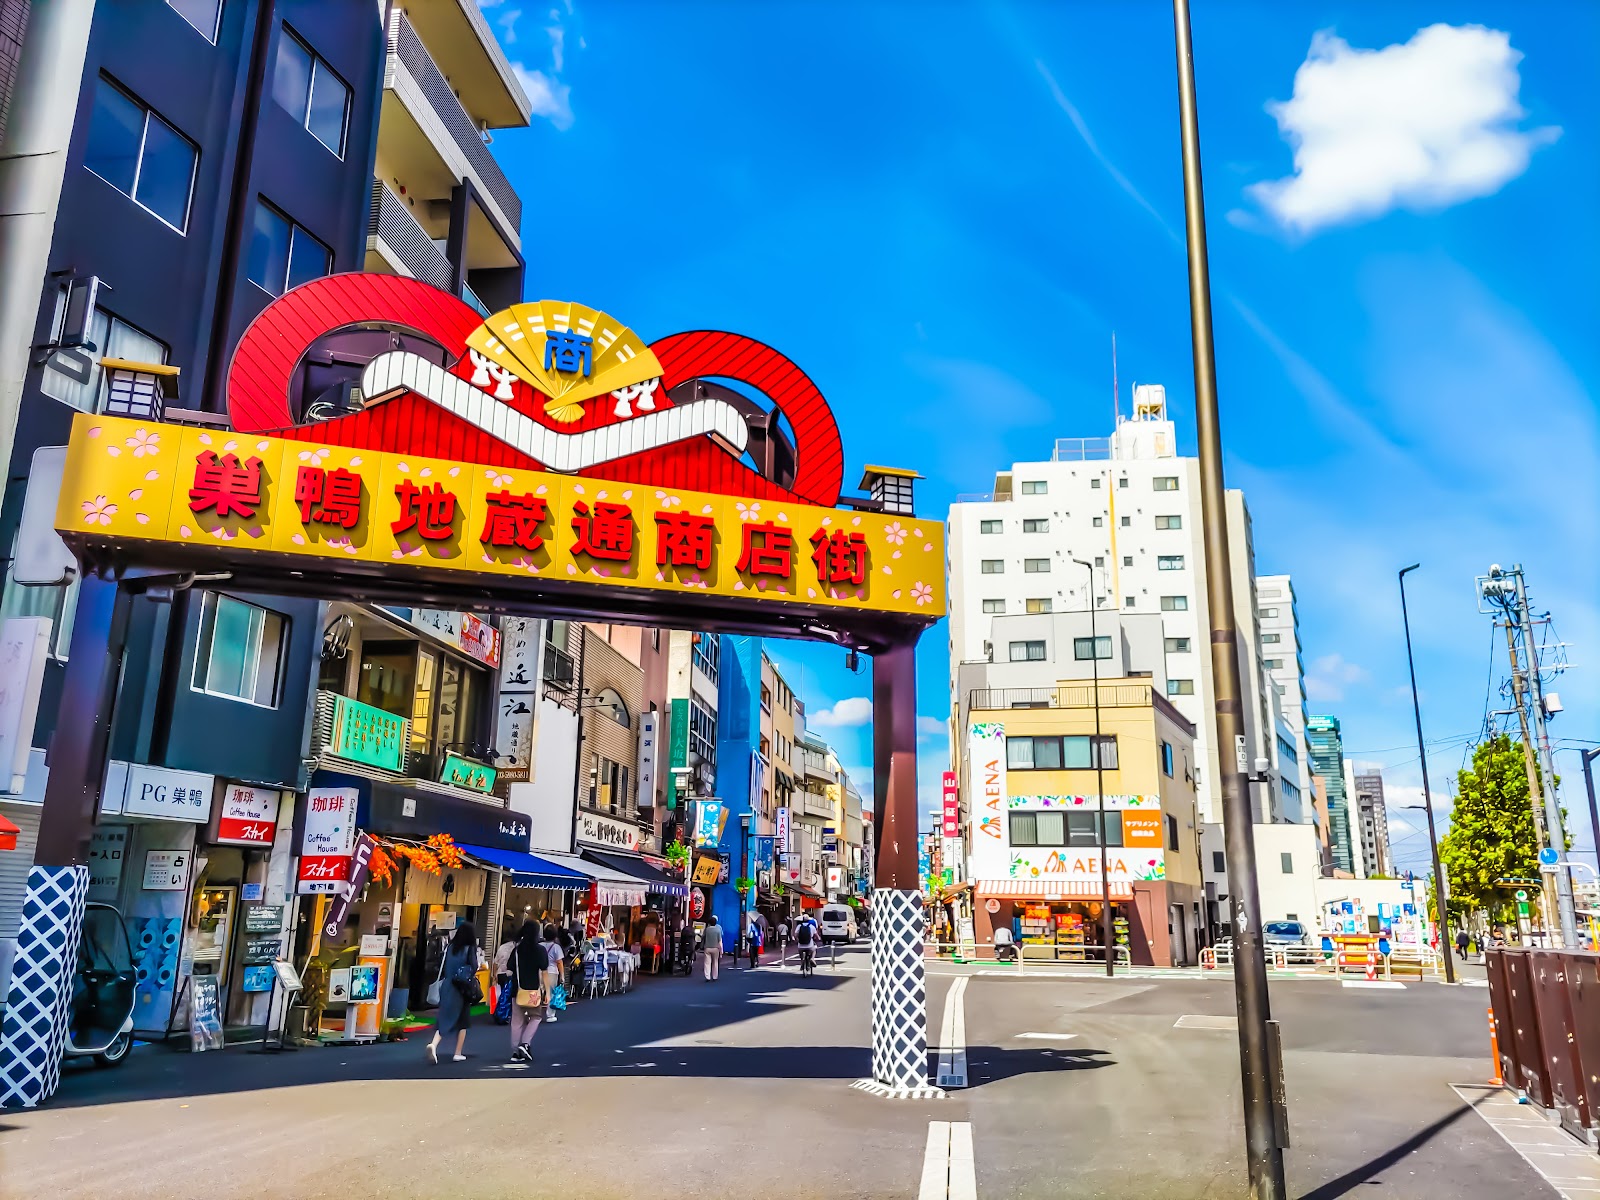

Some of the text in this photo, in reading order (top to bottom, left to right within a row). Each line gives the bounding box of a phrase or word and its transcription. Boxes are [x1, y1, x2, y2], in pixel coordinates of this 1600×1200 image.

[544, 328, 593, 377] 商
[188, 449, 867, 585] 巣鴨地蔵通商店街
[140, 783, 203, 807] PG 巣鴨
[984, 759, 1000, 811] AENA
[232, 788, 255, 806] 珈琲
[311, 795, 345, 813] 珈琲
[944, 777, 956, 831] 山和証券
[229, 807, 261, 819] Coffee House
[240, 822, 269, 840] スカイ
[307, 833, 331, 843] Coffee
[100, 849, 121, 860] 入口
[317, 844, 338, 853] House
[172, 855, 184, 884] 占い
[303, 857, 340, 877] スカイ
[337, 843, 371, 923] コーヒー
